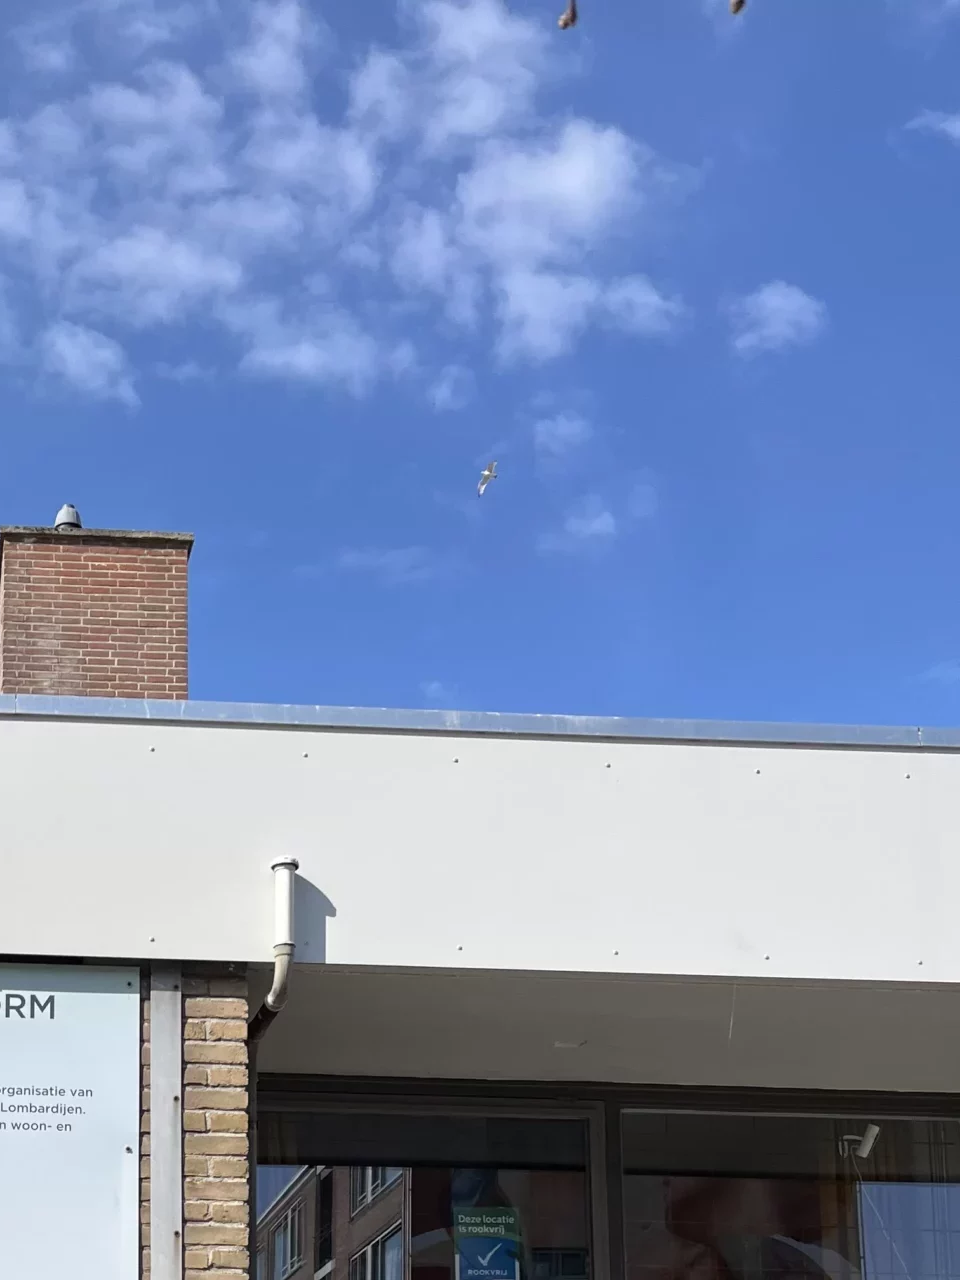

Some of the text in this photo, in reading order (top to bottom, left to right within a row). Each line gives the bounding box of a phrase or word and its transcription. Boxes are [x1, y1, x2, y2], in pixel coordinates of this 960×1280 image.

[70, 1088, 93, 1098] van
[0, 1102, 86, 1116] Lombardijen.
[10, 1122, 53, 1131] woon-
[56, 1123, 72, 1132] en
[458, 1214, 515, 1224] Deze locatie
[458, 1224, 505, 1235] is rookvrij
